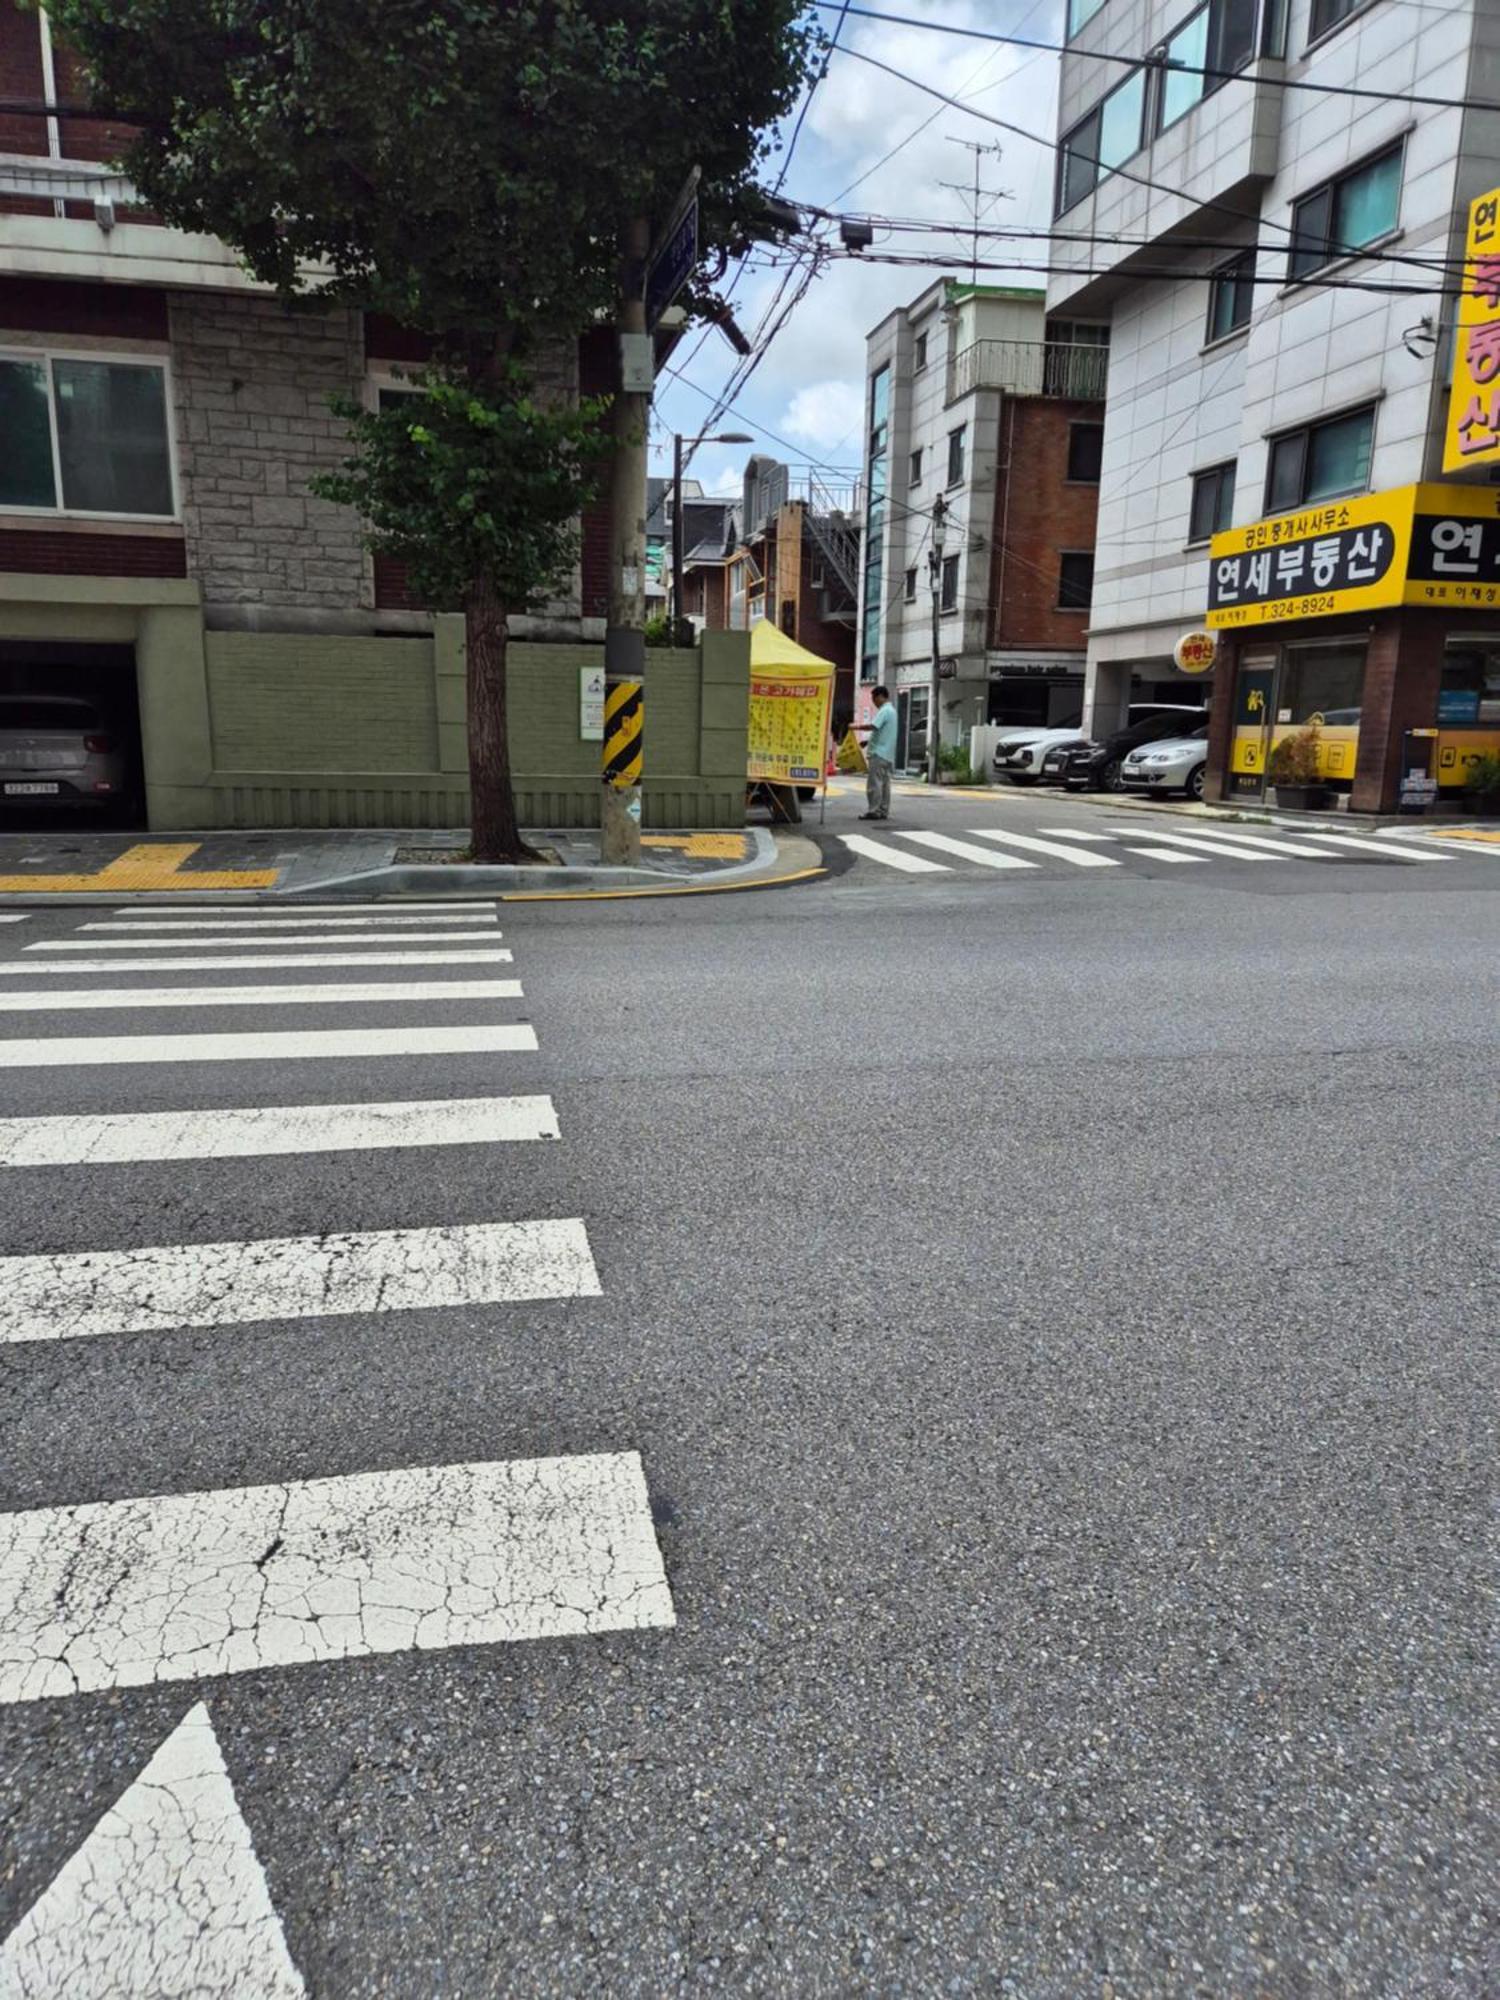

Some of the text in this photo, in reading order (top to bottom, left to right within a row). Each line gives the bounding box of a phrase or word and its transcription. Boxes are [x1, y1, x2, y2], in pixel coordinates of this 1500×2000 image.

[1216, 528, 1384, 602] 연세부동산
[1431, 520, 1500, 573] 연
[1260, 596, 1335, 620] T.324-8924
[1181, 642, 1214, 661] 부동산
